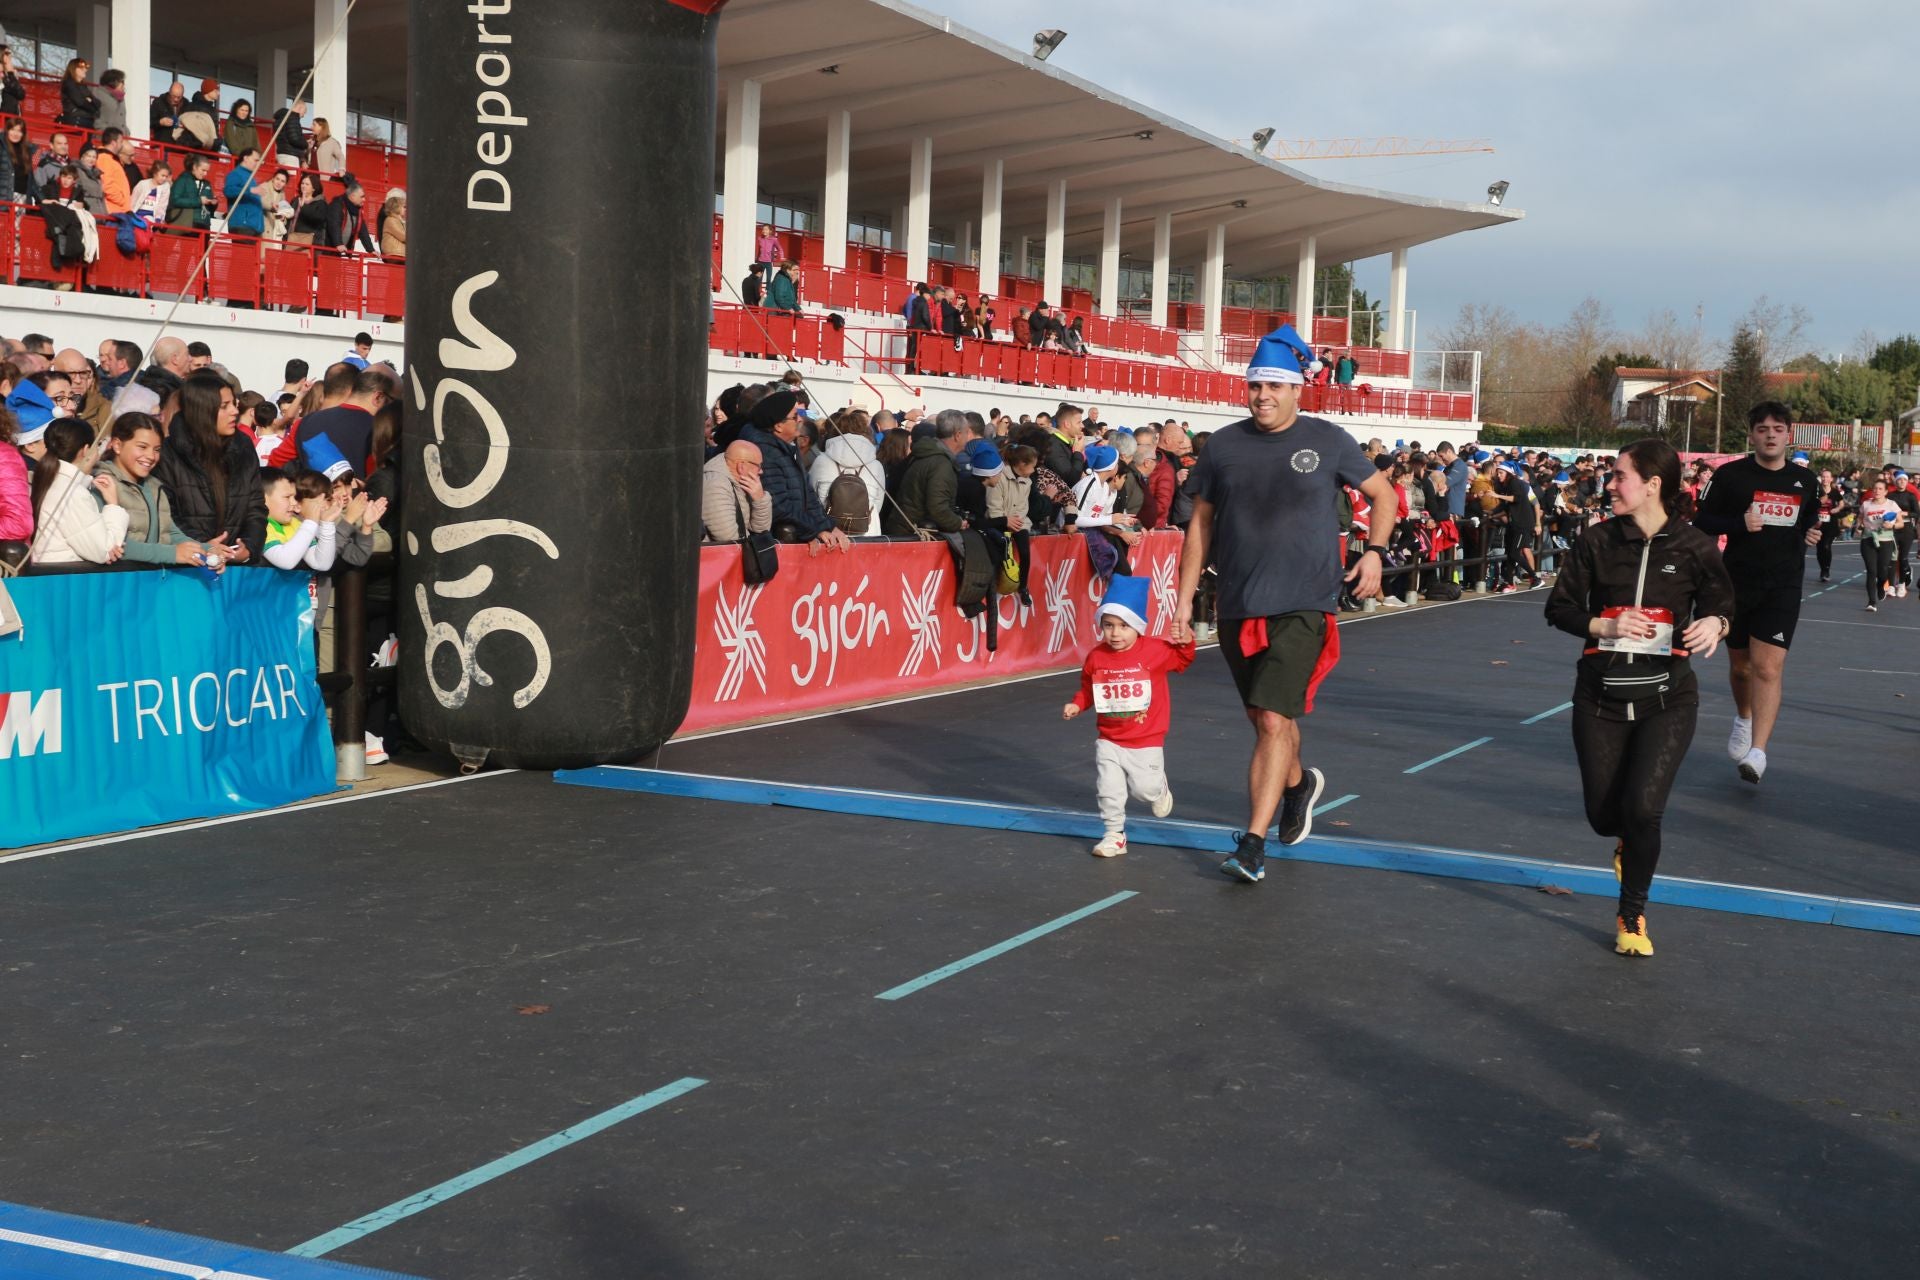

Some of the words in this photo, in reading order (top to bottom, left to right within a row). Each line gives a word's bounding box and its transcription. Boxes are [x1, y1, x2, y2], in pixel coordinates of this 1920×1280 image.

[230, 311, 237, 322] 9
[299, 318, 310, 329] 11
[407, 270, 560, 709] gijón
[1758, 503, 1794, 518] 1430
[791, 574, 891, 687] gijón
[1102, 682, 1144, 700] 3188
[97, 664, 307, 744] TRIOCAR
